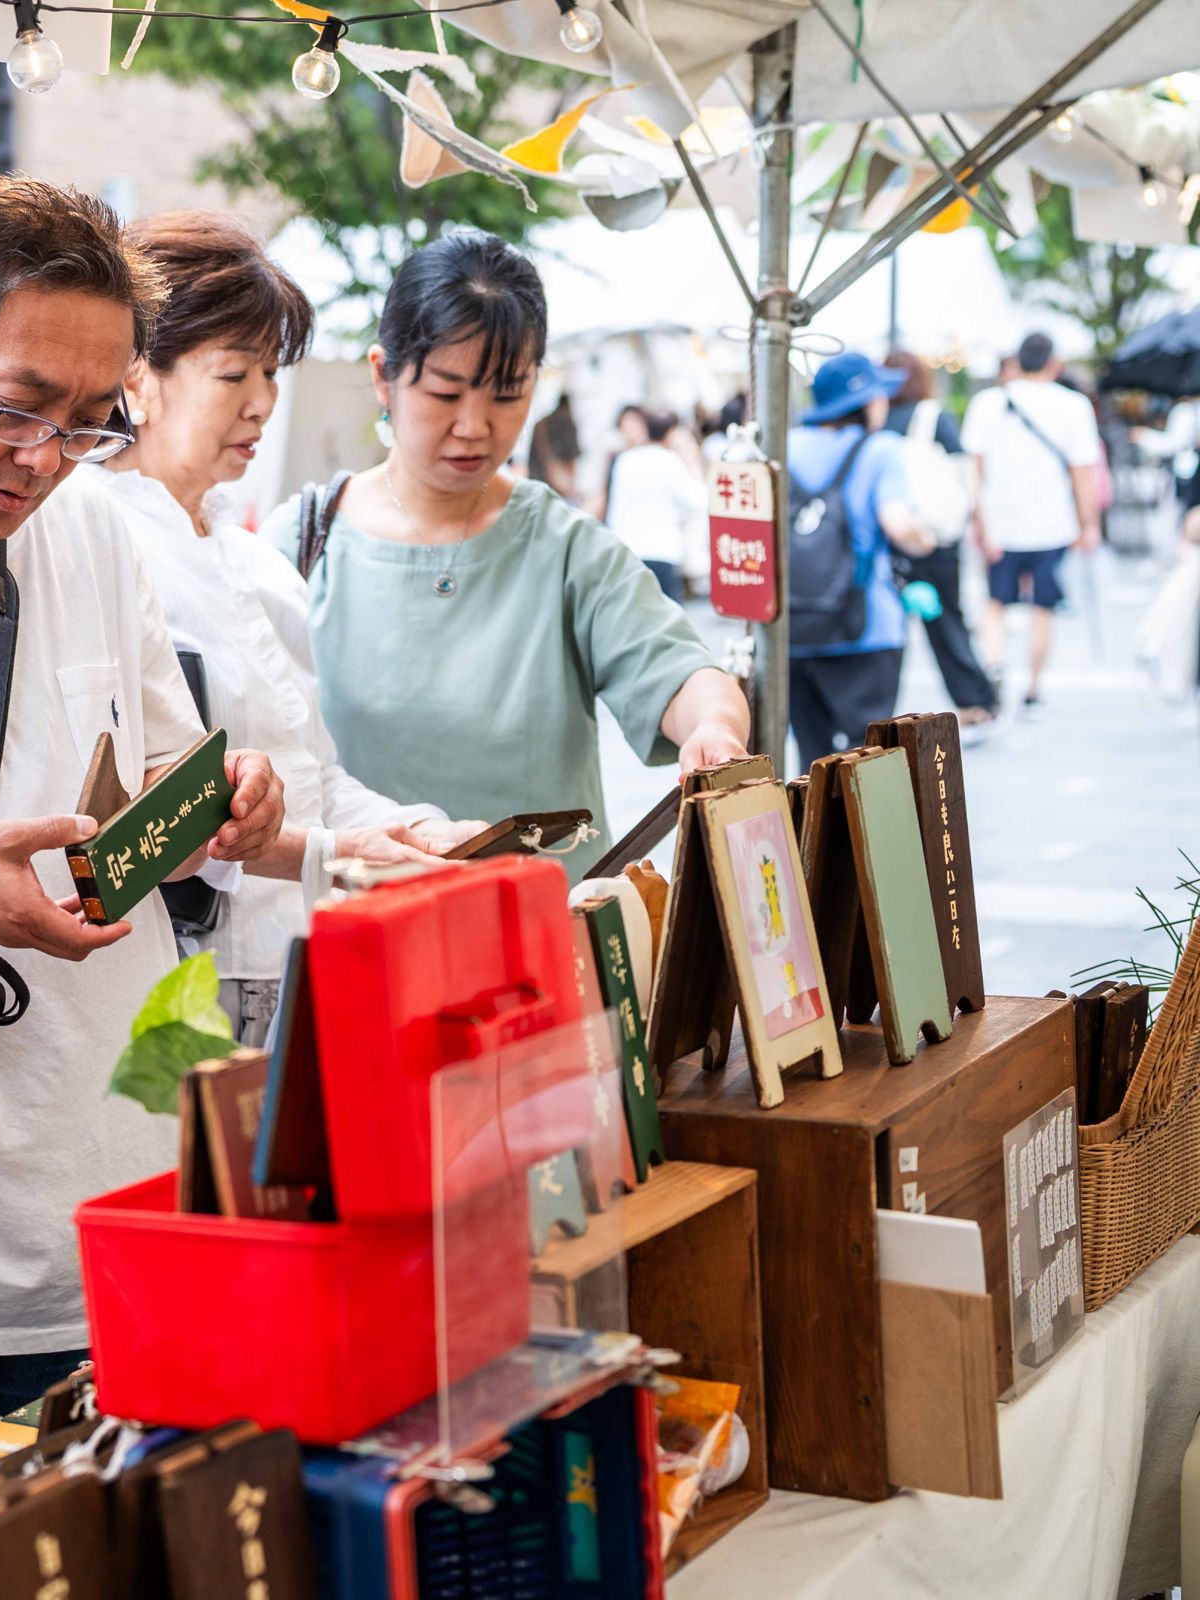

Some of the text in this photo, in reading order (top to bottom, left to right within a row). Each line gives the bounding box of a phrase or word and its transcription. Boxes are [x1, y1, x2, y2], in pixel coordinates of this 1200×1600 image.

[107, 779, 216, 890] 完売しました
[933, 743, 961, 950] 今日も良い一日を
